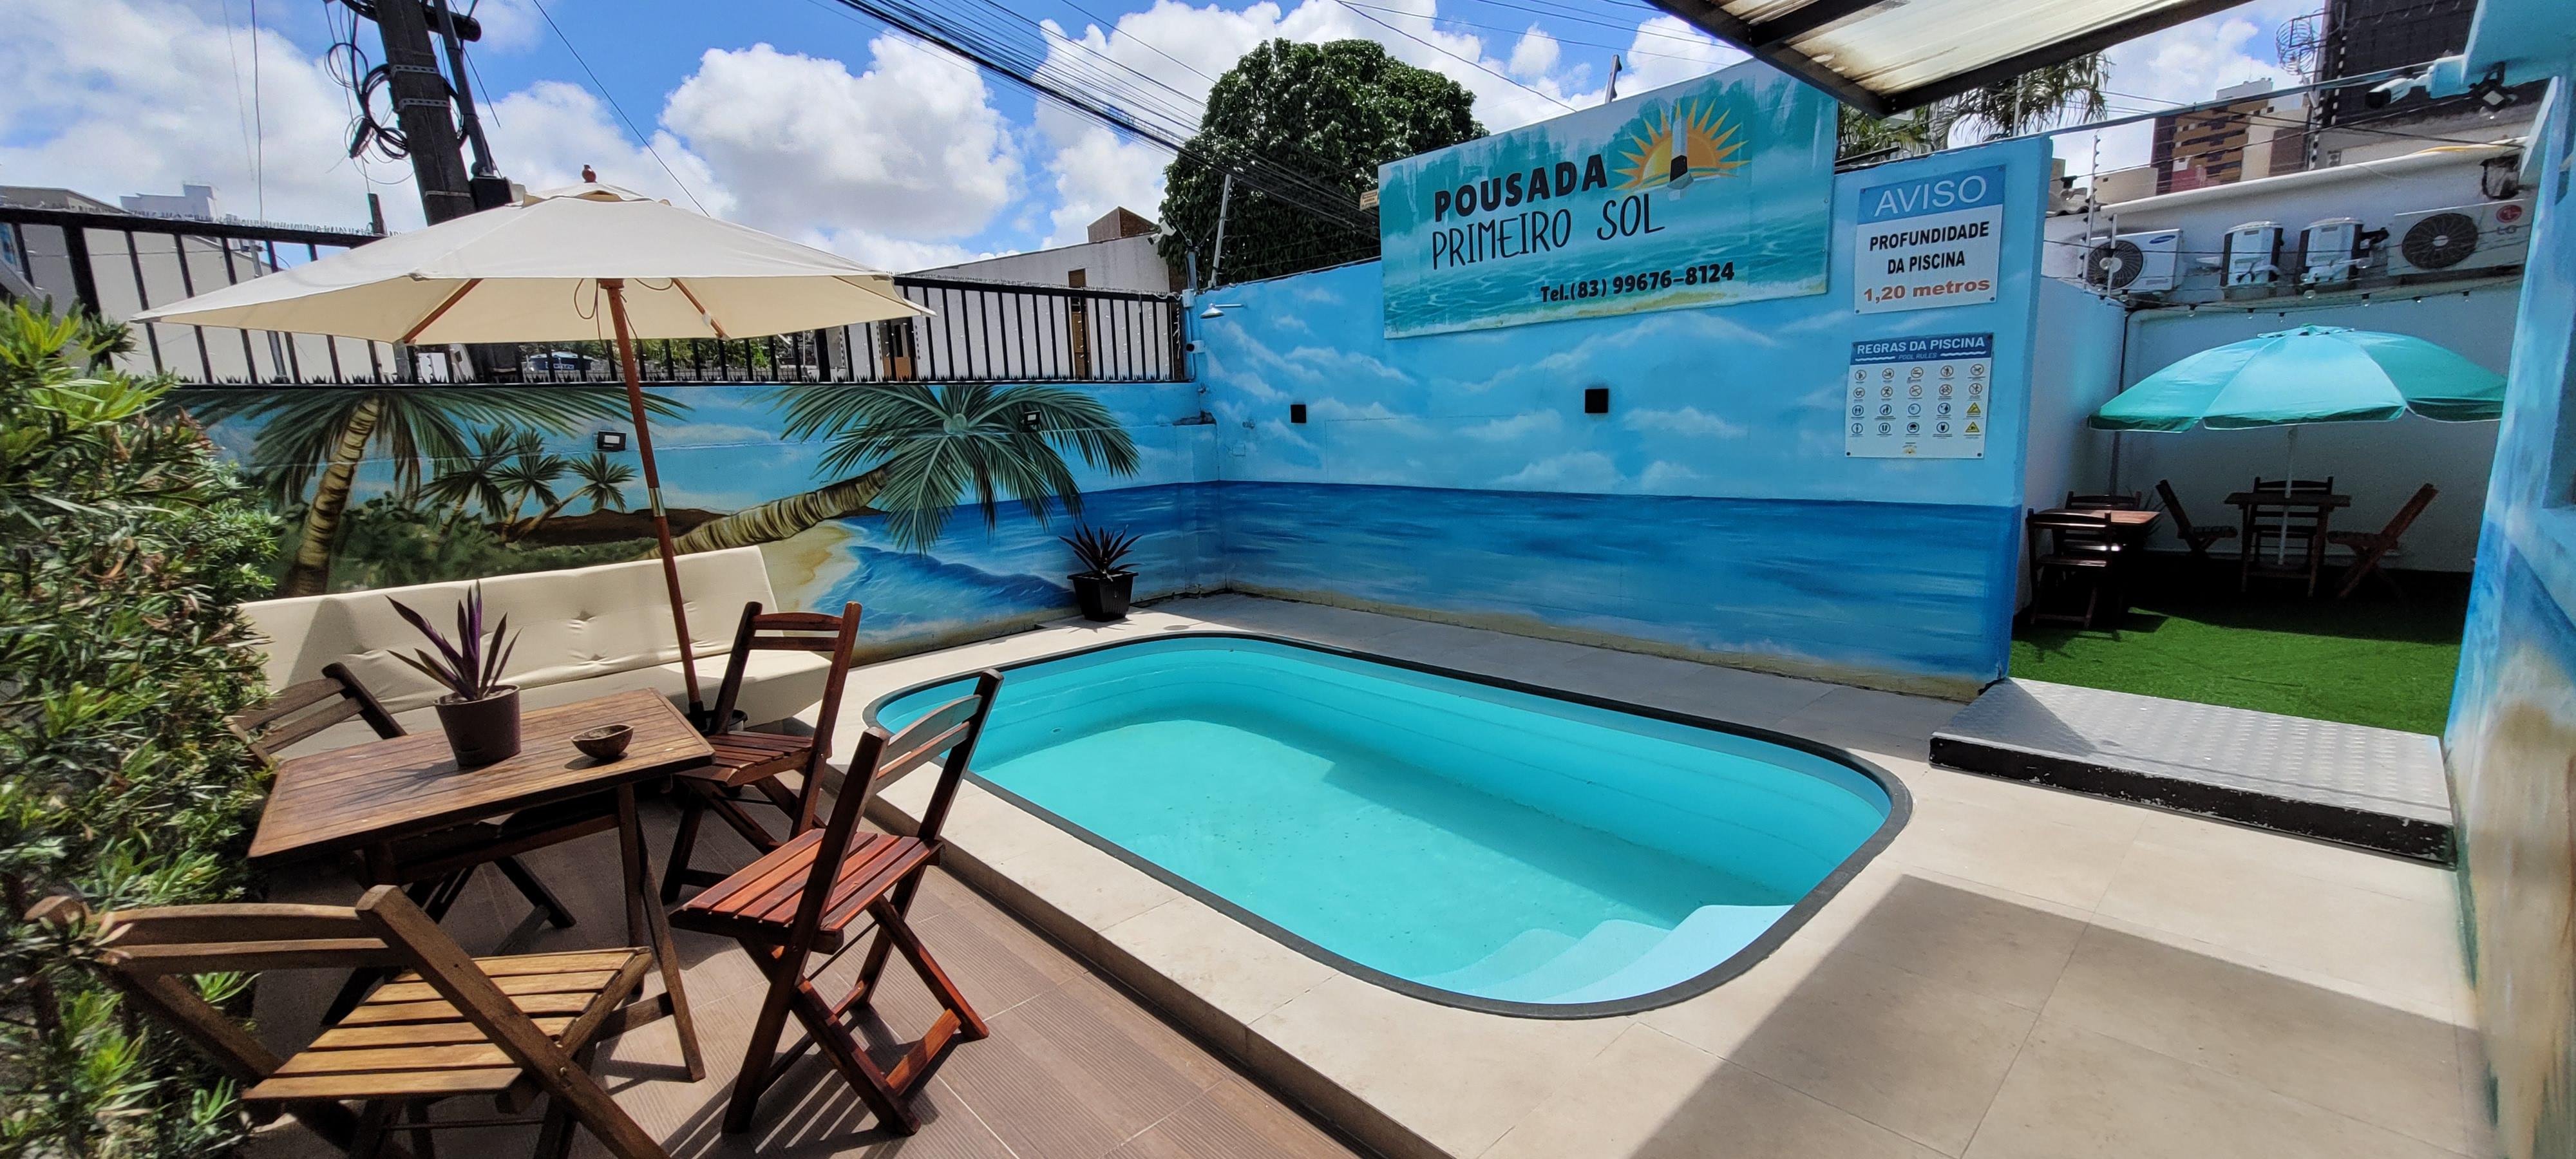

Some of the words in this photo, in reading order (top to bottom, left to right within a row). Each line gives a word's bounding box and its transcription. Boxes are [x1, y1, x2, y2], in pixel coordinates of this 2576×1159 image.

[1434, 153, 1608, 222] POUSADA
[1874, 175, 1987, 217] AVISO
[1432, 208, 1572, 270] PRIMEIRO
[1596, 193, 1665, 241] SOL
[1870, 221, 1989, 251] PROFUNDIDADE
[1612, 261, 1735, 296] 99676-8124
[1888, 258, 1904, 274] DA
[1909, 251, 1965, 272] PISCINA
[1864, 285, 1906, 304] 1,20
[1913, 279, 1990, 297] metros
[1857, 342, 1907, 355] REGRAS
[1909, 341, 1926, 352] DA
[1930, 337, 1985, 350] PISCINA
